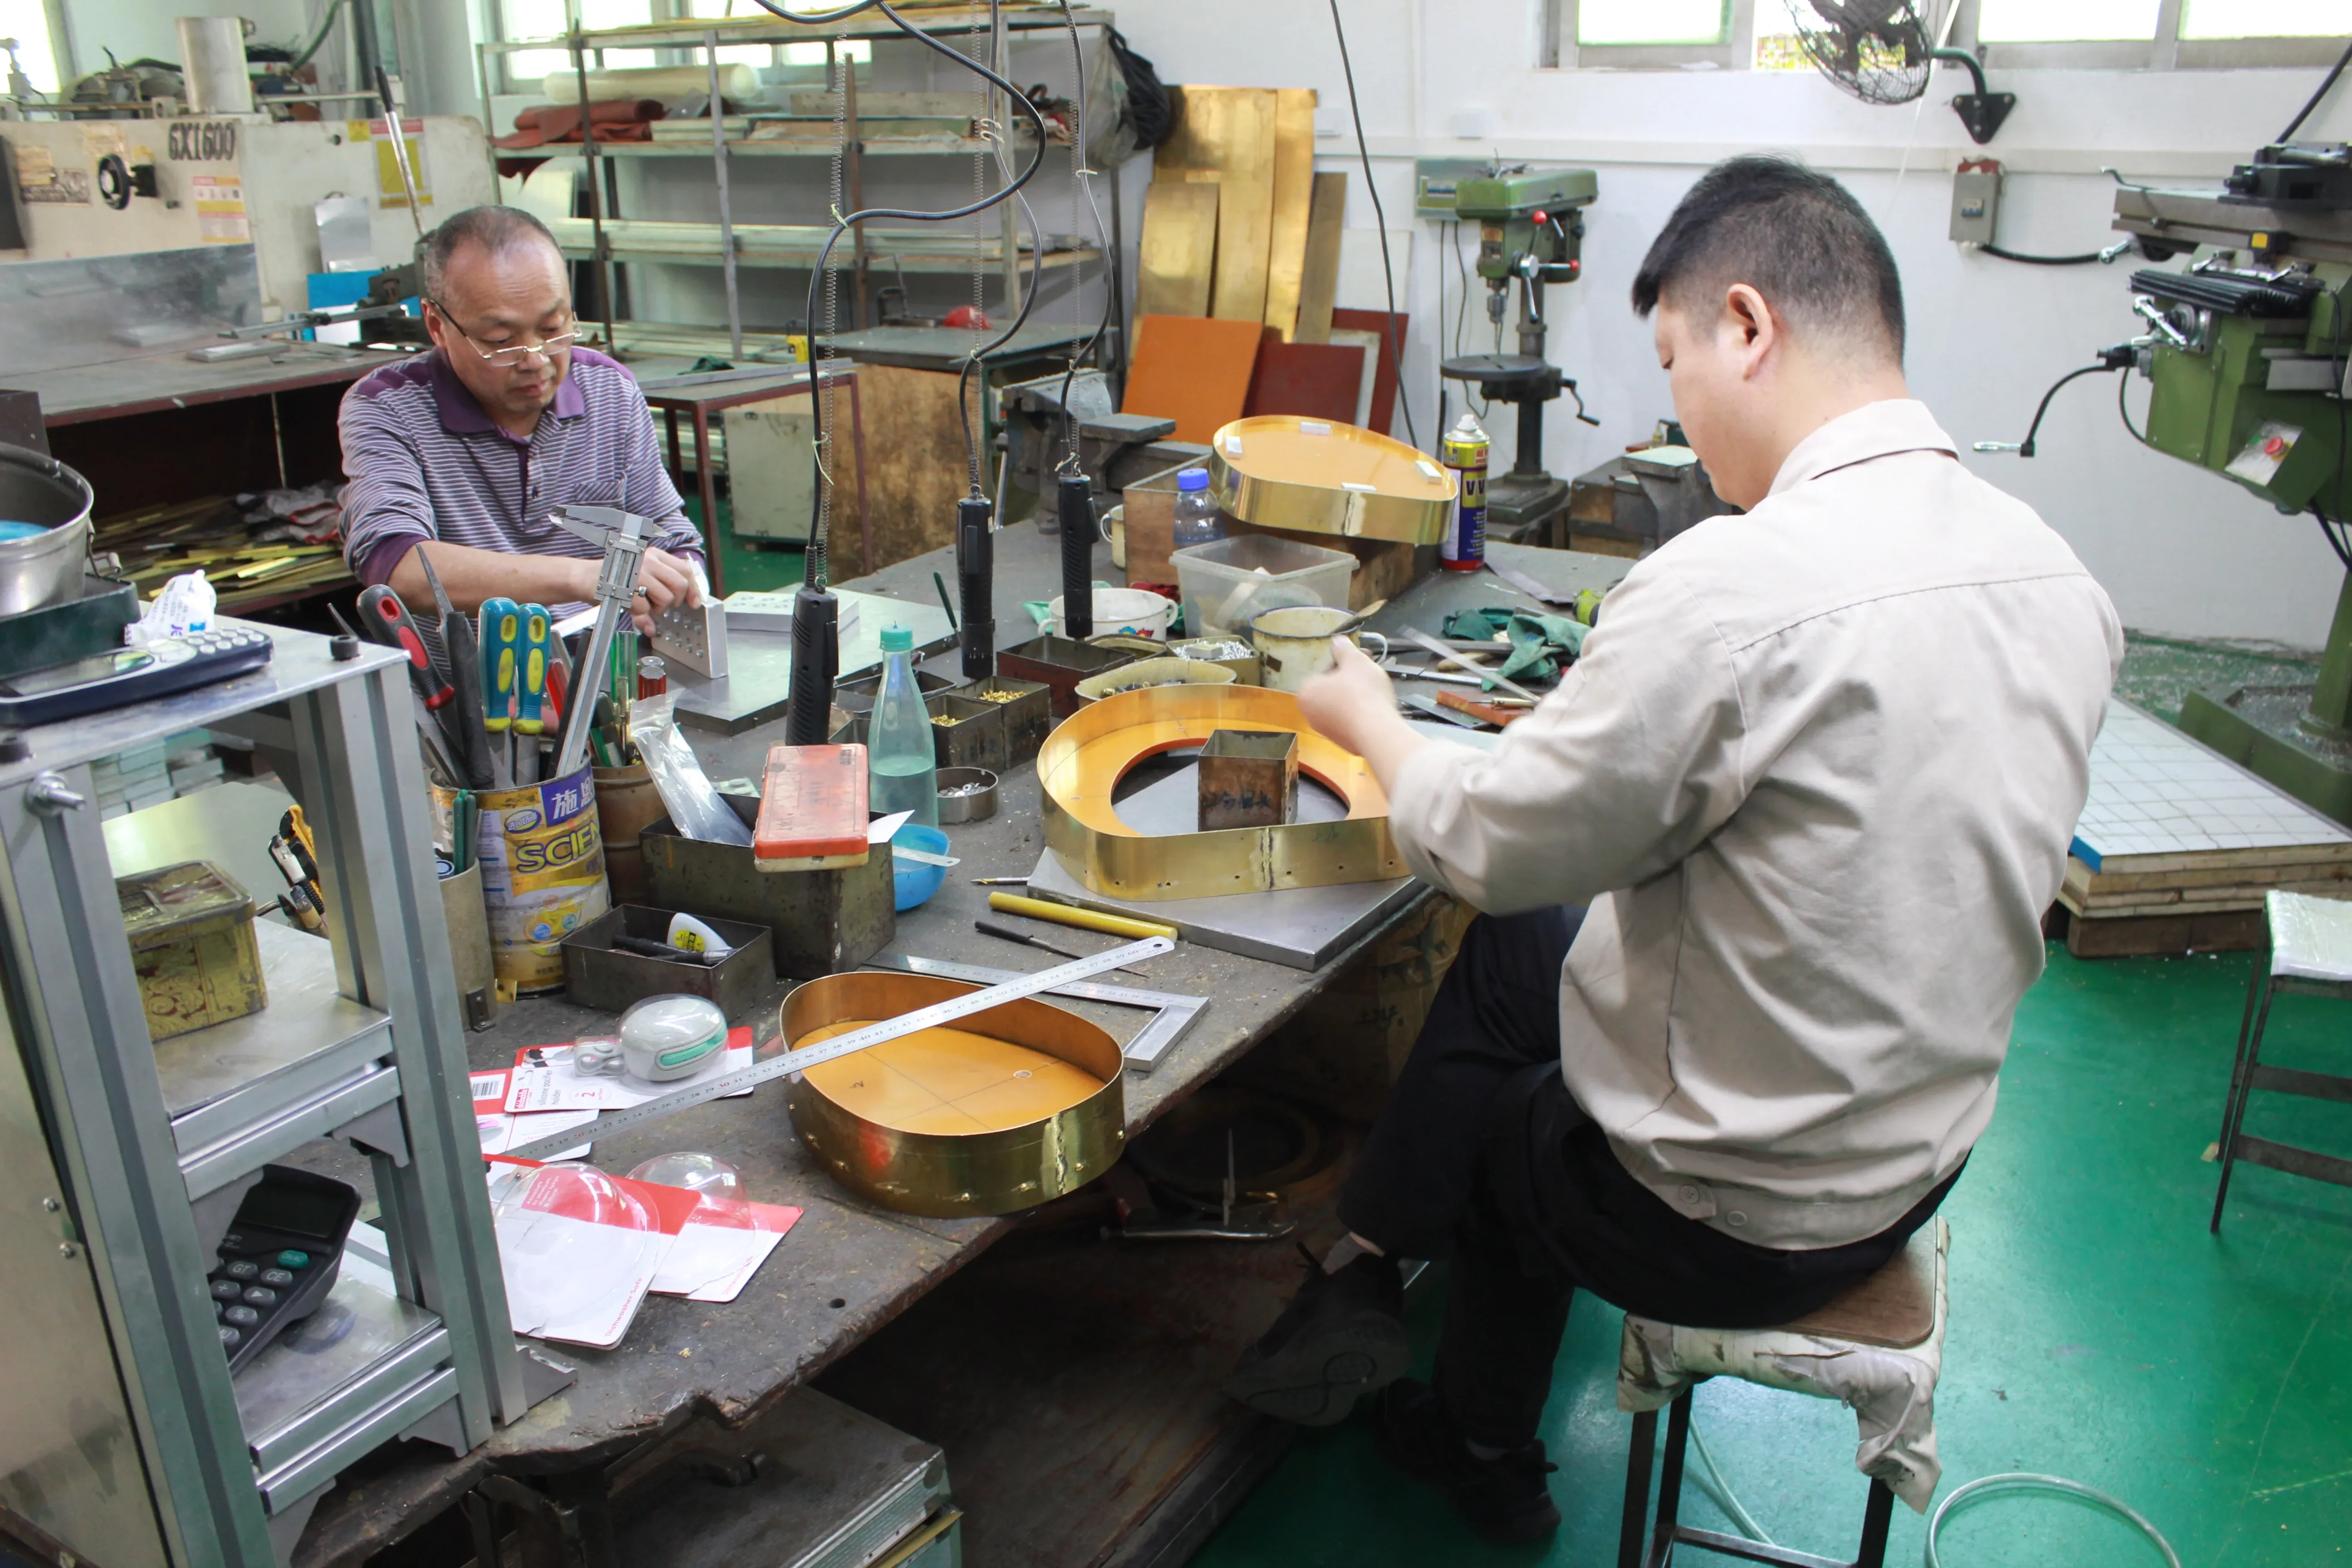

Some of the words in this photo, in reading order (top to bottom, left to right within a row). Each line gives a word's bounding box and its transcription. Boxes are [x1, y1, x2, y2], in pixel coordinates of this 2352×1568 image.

[538, 1088, 549, 1105] silicone
[544, 1070, 553, 1088] pacifier
[551, 1089, 561, 1105] holder
[233, 1264, 251, 1274] GT
[267, 1272, 285, 1281] CE
[605, 1296, 633, 1337] Dishwasher
[630, 1278, 643, 1294] Safe
